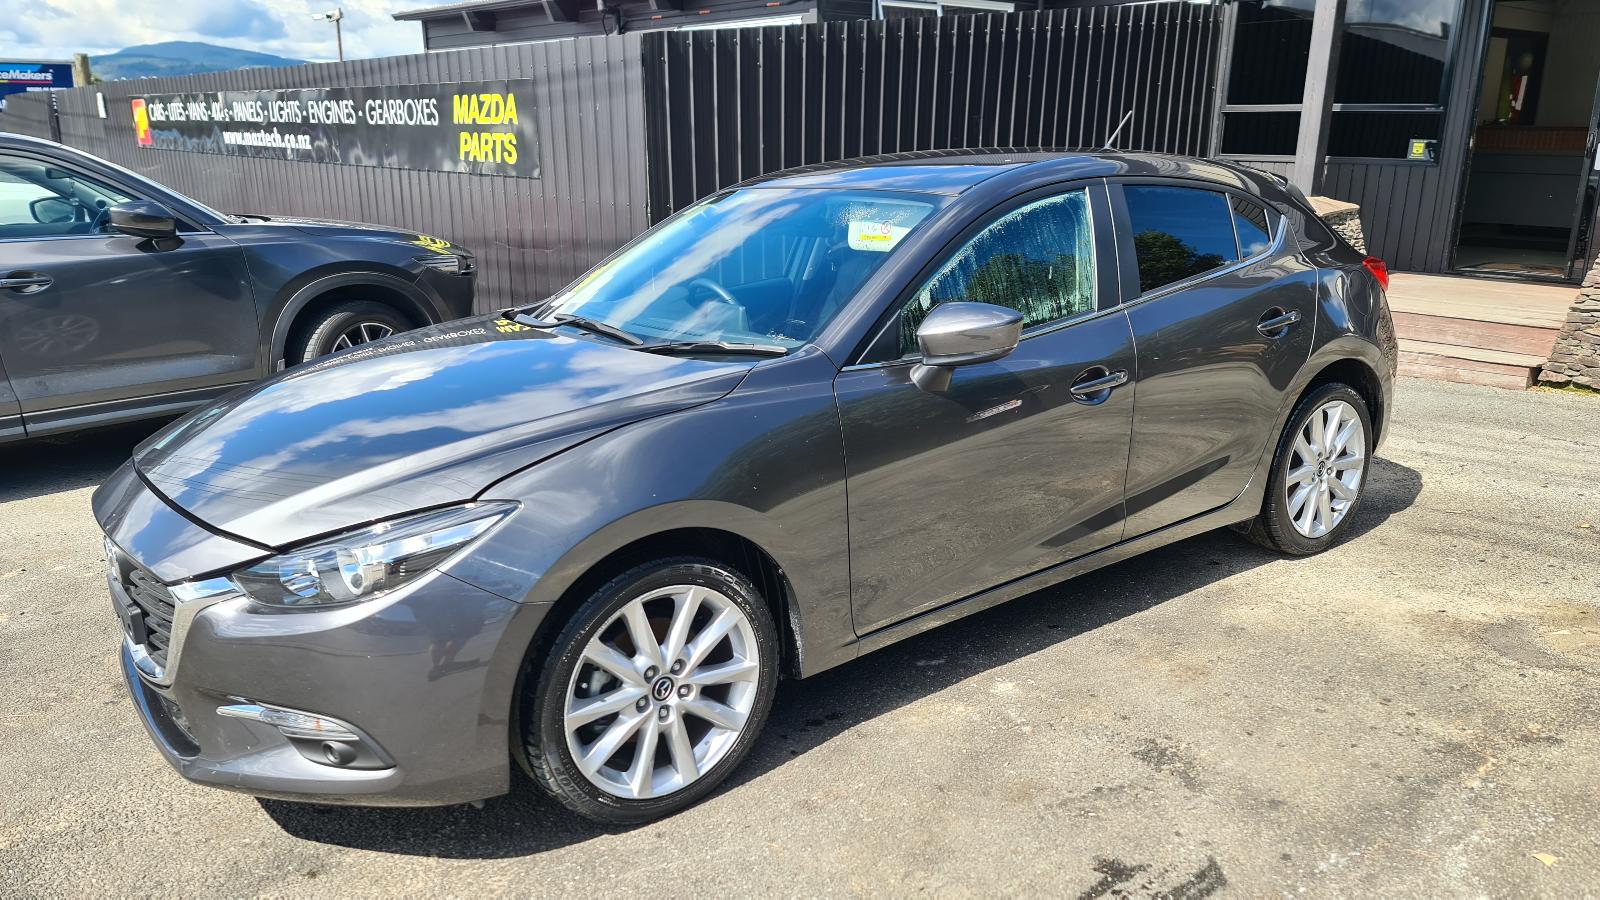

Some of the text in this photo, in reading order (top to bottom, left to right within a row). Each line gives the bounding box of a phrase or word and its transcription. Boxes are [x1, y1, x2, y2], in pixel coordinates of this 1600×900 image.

[148, 103, 166, 121] CARS
[167, 102, 186, 121] UTES
[187, 102, 208, 121] VANS
[233, 101, 263, 122] PANELS
[268, 101, 302, 123] LIGHTS
[308, 99, 356, 125] ENGINES
[365, 98, 439, 126] GEARBOXES
[453, 93, 518, 125] MAZDA
[222, 127, 311, 149] www.maztech.co.nz
[459, 131, 517, 164] PARTS
